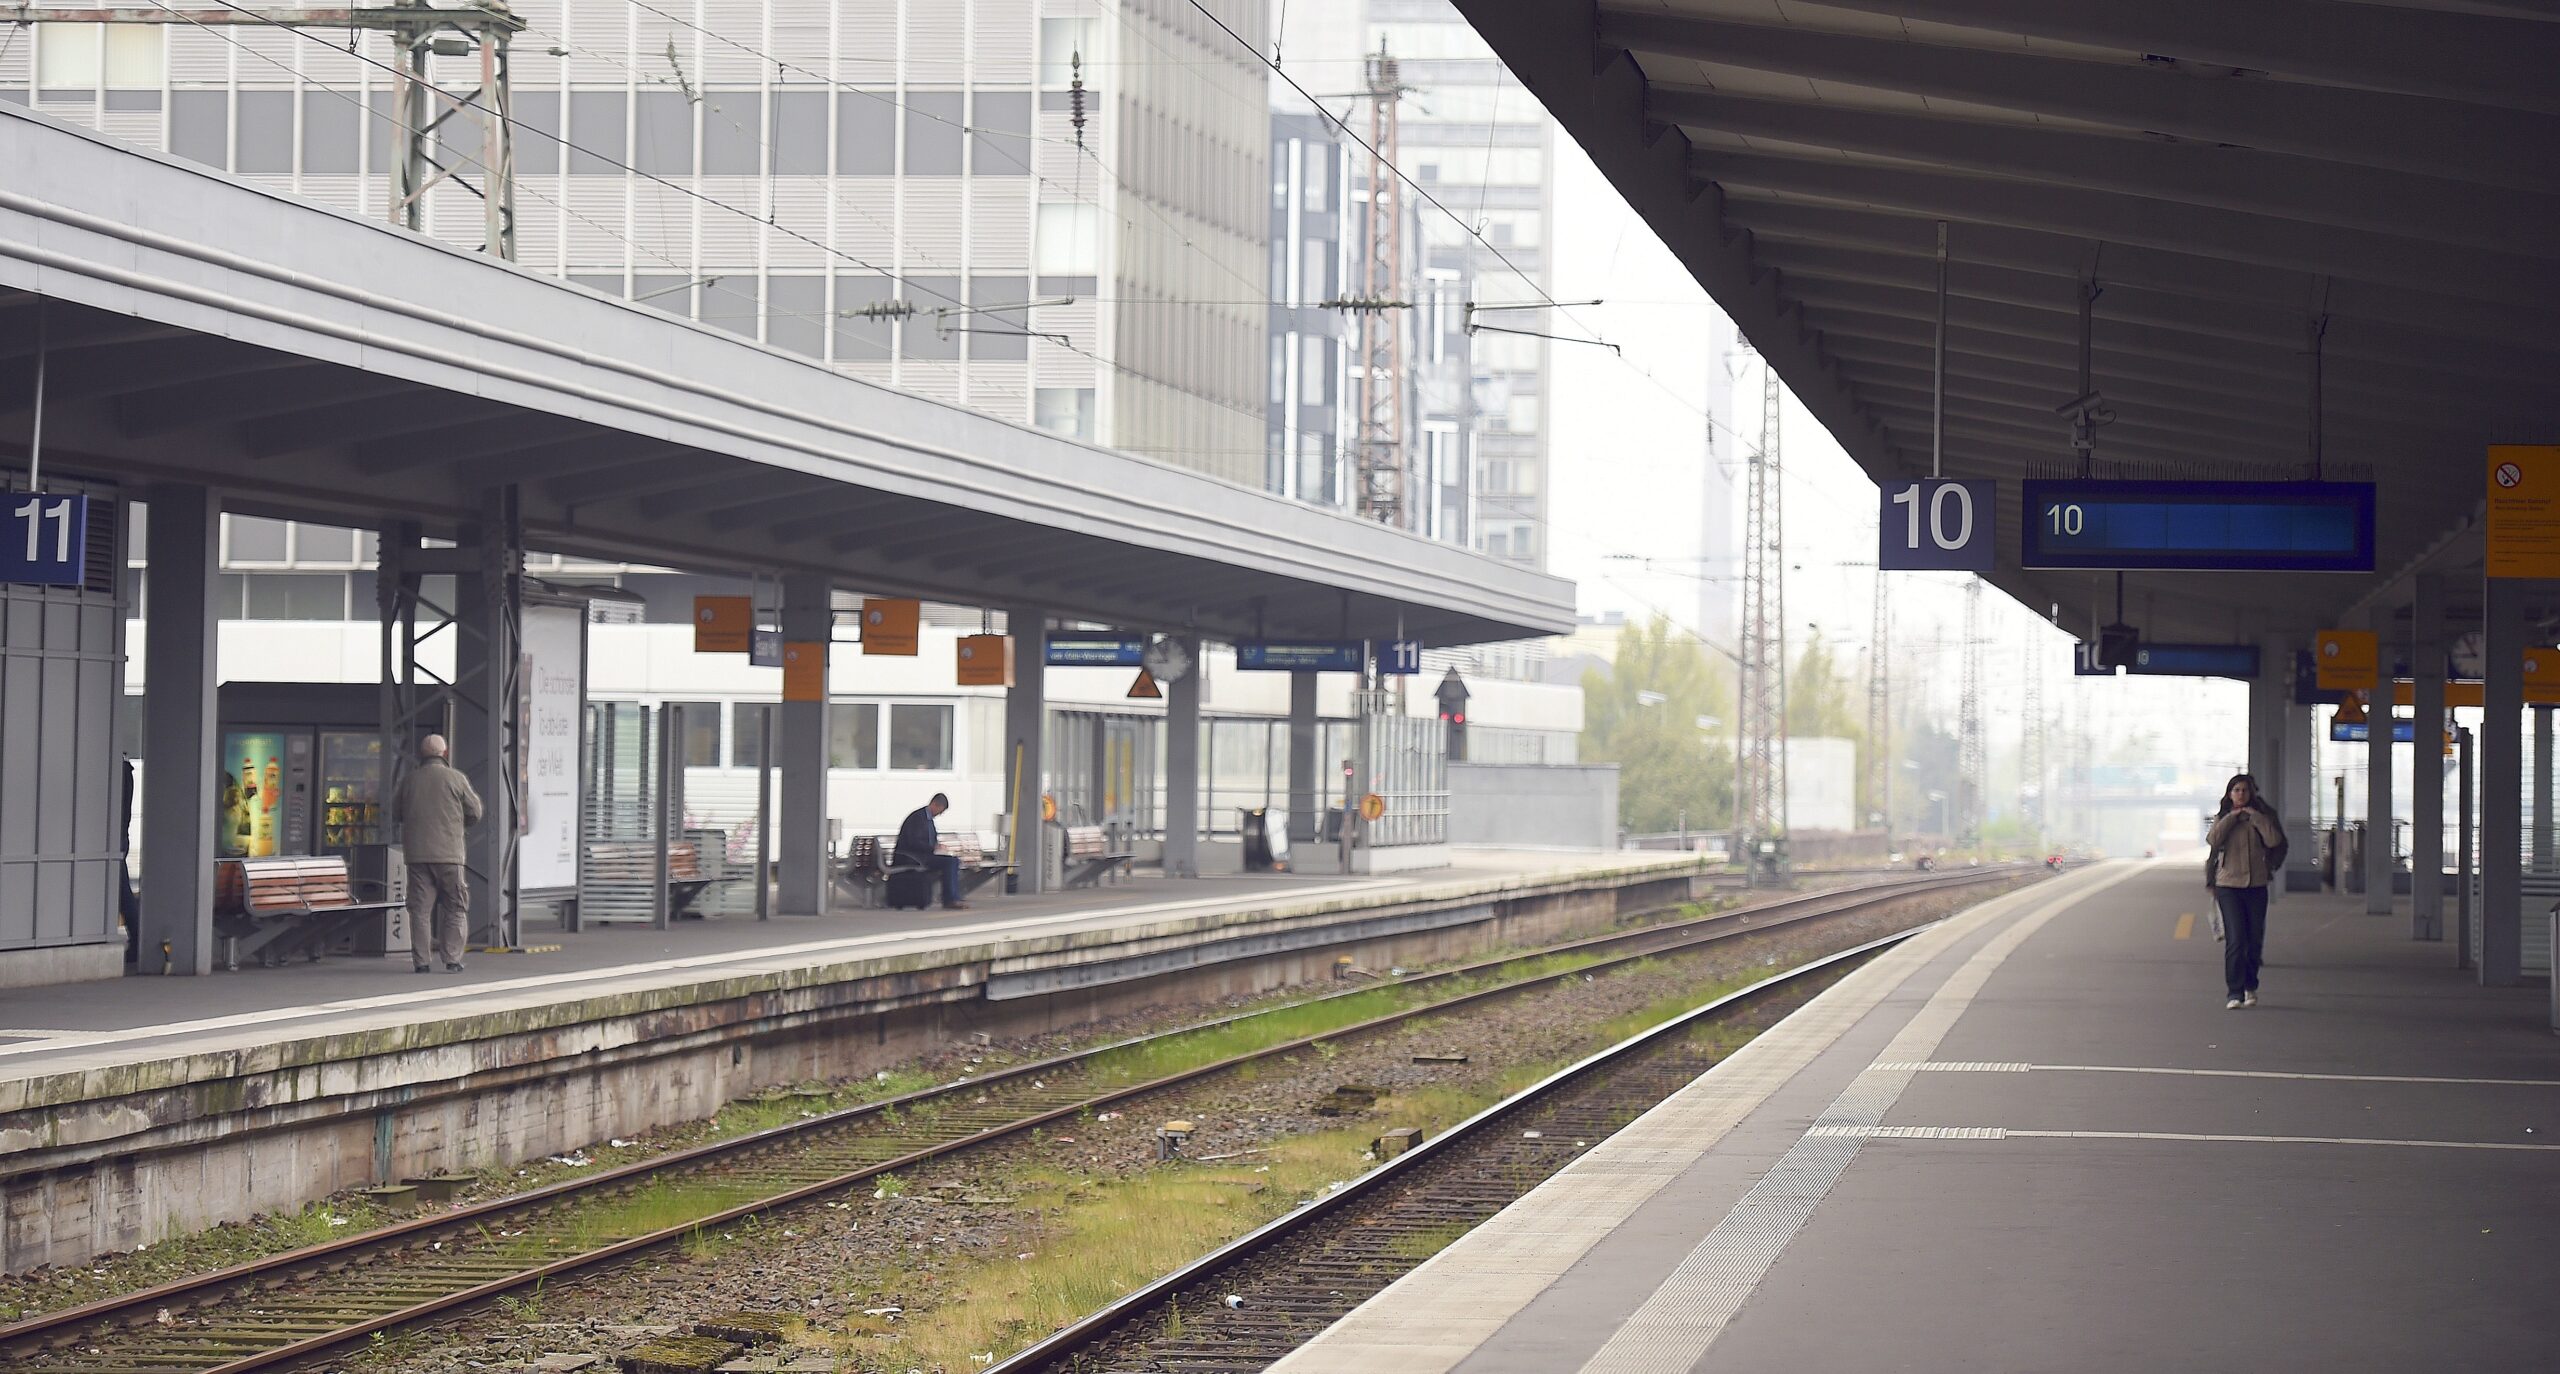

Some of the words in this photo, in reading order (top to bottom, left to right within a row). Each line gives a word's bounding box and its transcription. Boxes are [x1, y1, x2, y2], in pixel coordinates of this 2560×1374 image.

[14, 498, 70, 562] 11
[1893, 482, 1973, 550] 10
[2046, 504, 2084, 536] 10
[1391, 641, 1418, 669] 11
